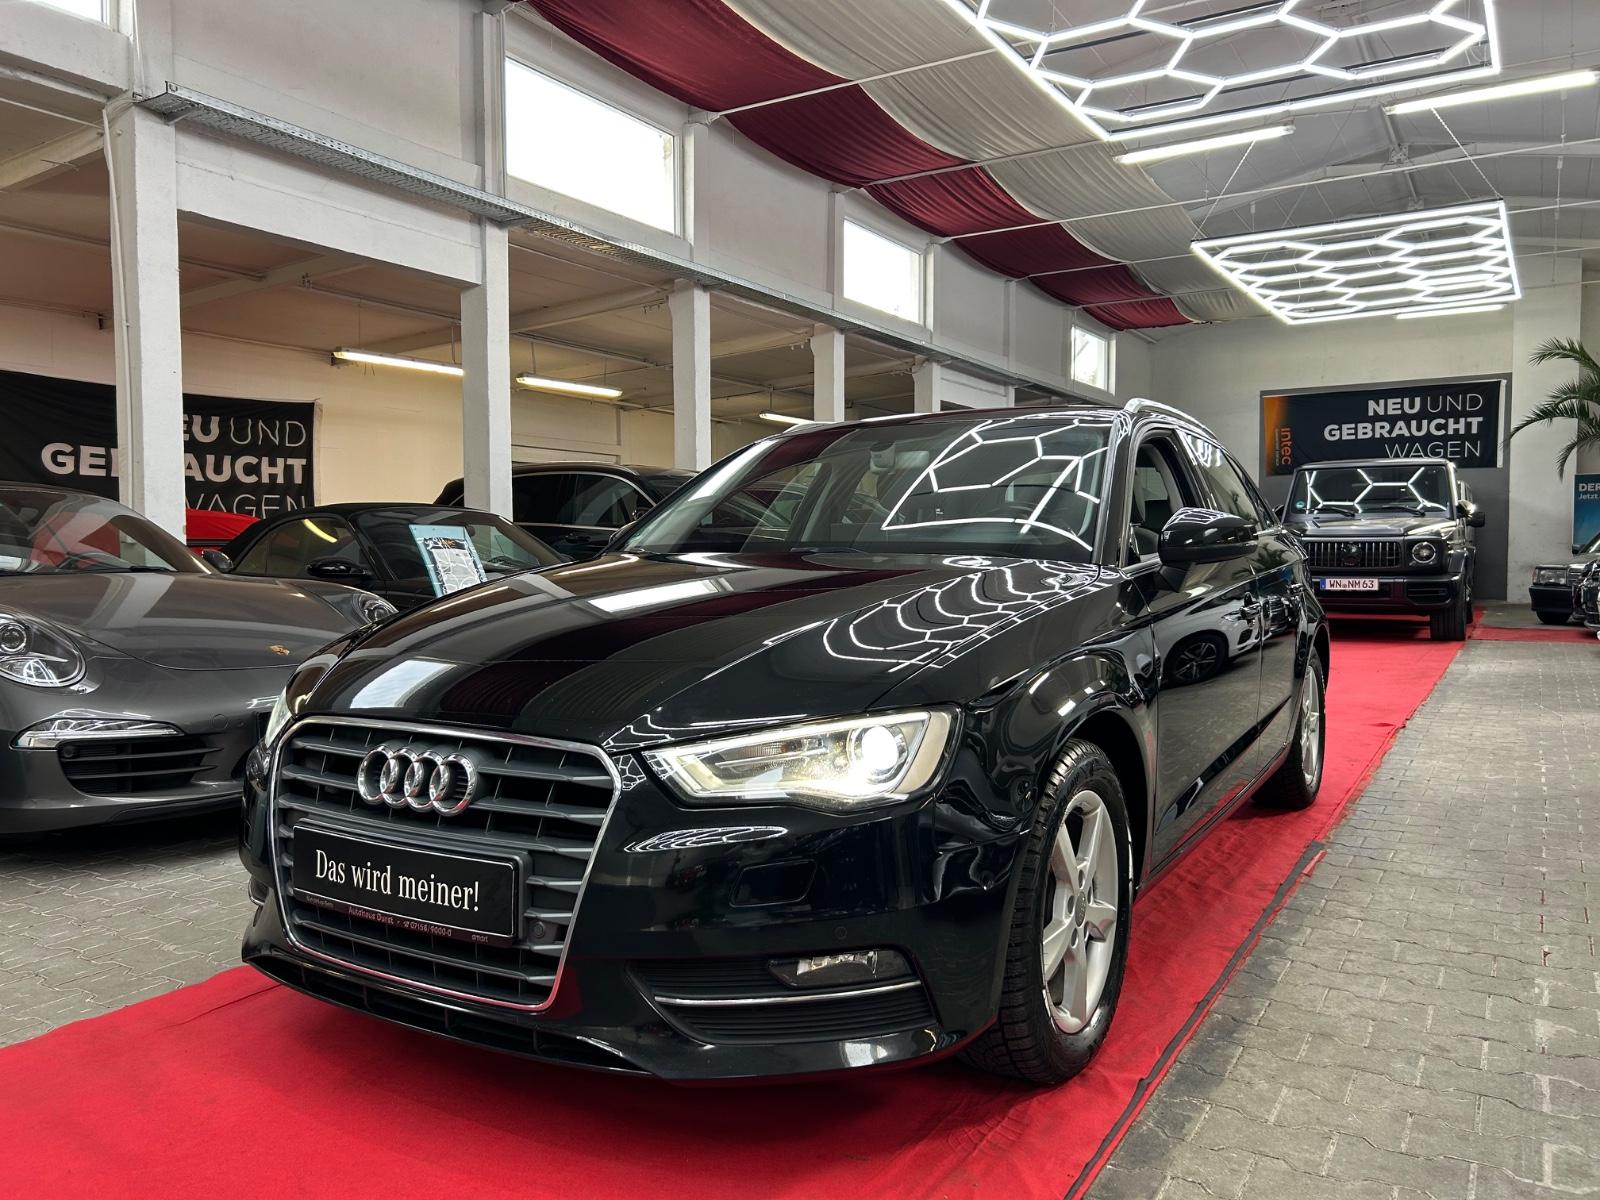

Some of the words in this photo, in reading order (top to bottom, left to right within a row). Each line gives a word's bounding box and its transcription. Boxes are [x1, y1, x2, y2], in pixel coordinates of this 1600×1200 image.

[1367, 396, 1421, 417] NEU
[1427, 393, 1483, 412] UND
[230, 417, 307, 447] UND
[1323, 416, 1484, 441] GEBRAUCHT
[1384, 440, 1481, 460] WAGEN
[1329, 579, 1342, 589] WN
[1347, 579, 1361, 589] NM
[1362, 579, 1374, 589] 63
[315, 849, 346, 885] Das
[351, 861, 392, 895] wird
[398, 873, 480, 912] meiner!
